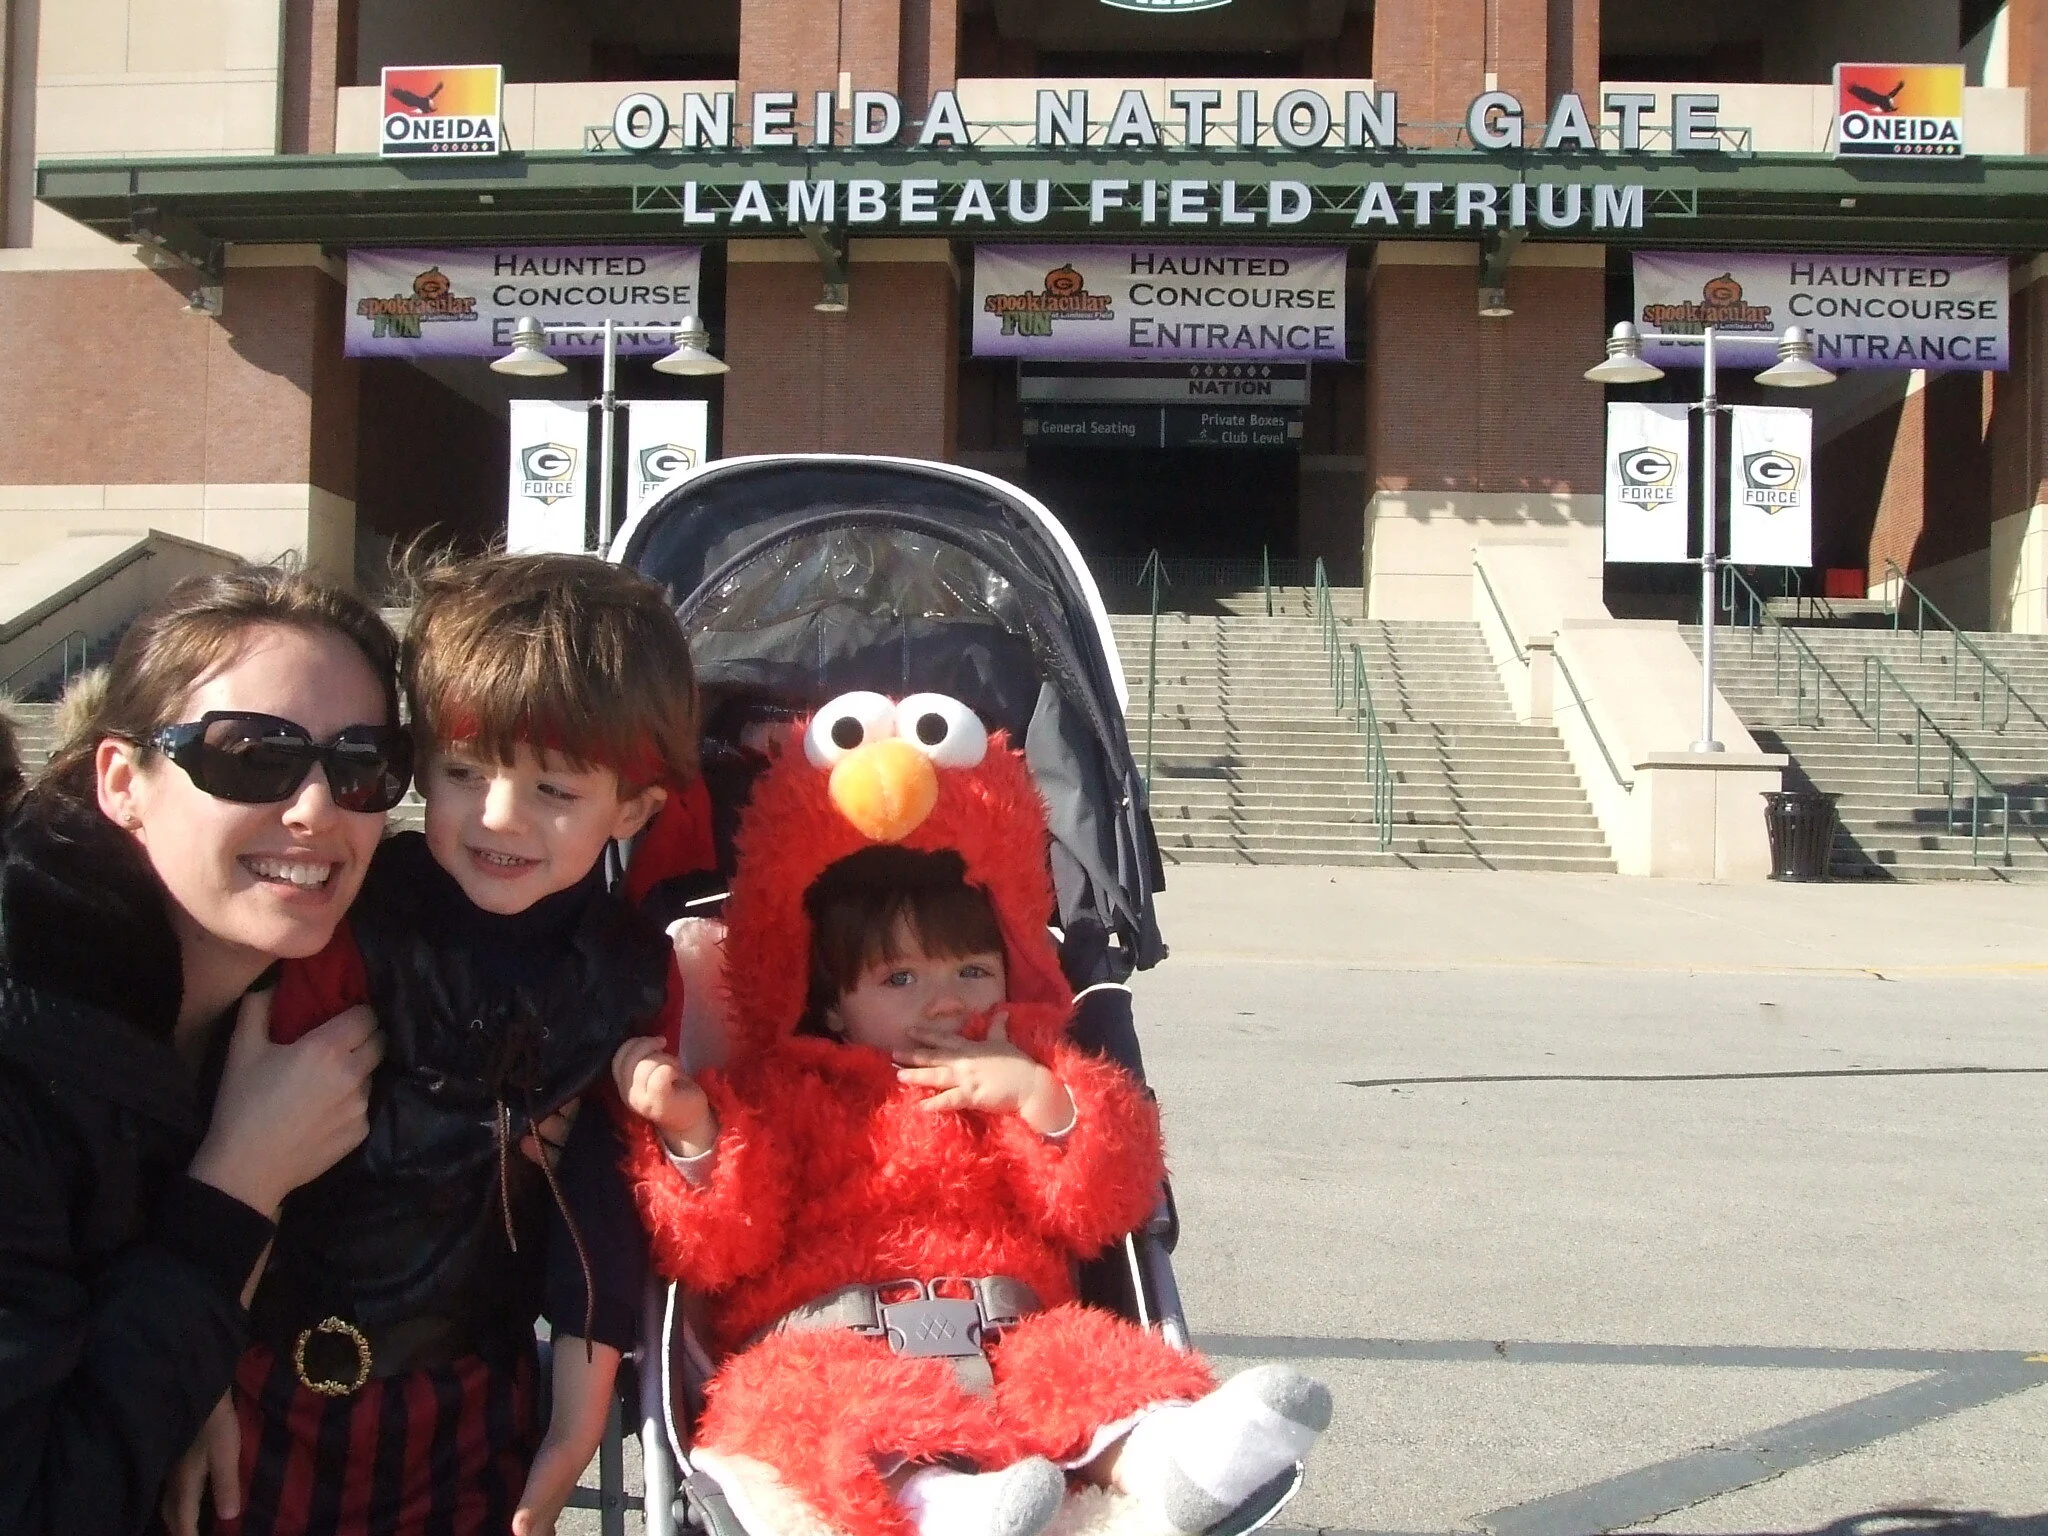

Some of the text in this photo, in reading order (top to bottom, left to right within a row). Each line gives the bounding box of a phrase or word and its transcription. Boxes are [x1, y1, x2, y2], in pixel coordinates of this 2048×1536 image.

[386, 115, 493, 140] ONEIDA
[613, 89, 1721, 152] ONEIDA NATION GATE
[1842, 113, 1958, 141] ONEIDA
[682, 179, 1645, 229] LAMBEAU FIELD ATRIUM
[493, 255, 646, 276] HAUNTED
[1130, 253, 1290, 276] HAUNTED
[1789, 263, 1950, 288] HAUNTED
[493, 284, 691, 306] CONCOURSE
[1129, 283, 1335, 308] CONCOURSE
[1788, 293, 1998, 320] CONCOURSE
[493, 317, 686, 346] ETRANC
[1001, 311, 1053, 336] FUN
[1129, 317, 1335, 350] ENTRANCE
[1804, 328, 1997, 361] NTRANCE
[1188, 380, 1272, 395] NATION
[1041, 421, 1136, 436] General Seating
[1201, 413, 1285, 426] Private Boxes
[1221, 431, 1285, 444] Club Level
[524, 482, 573, 494] FORCE
[1622, 488, 1674, 500] FORCE
[1746, 491, 1797, 503] FORCE
